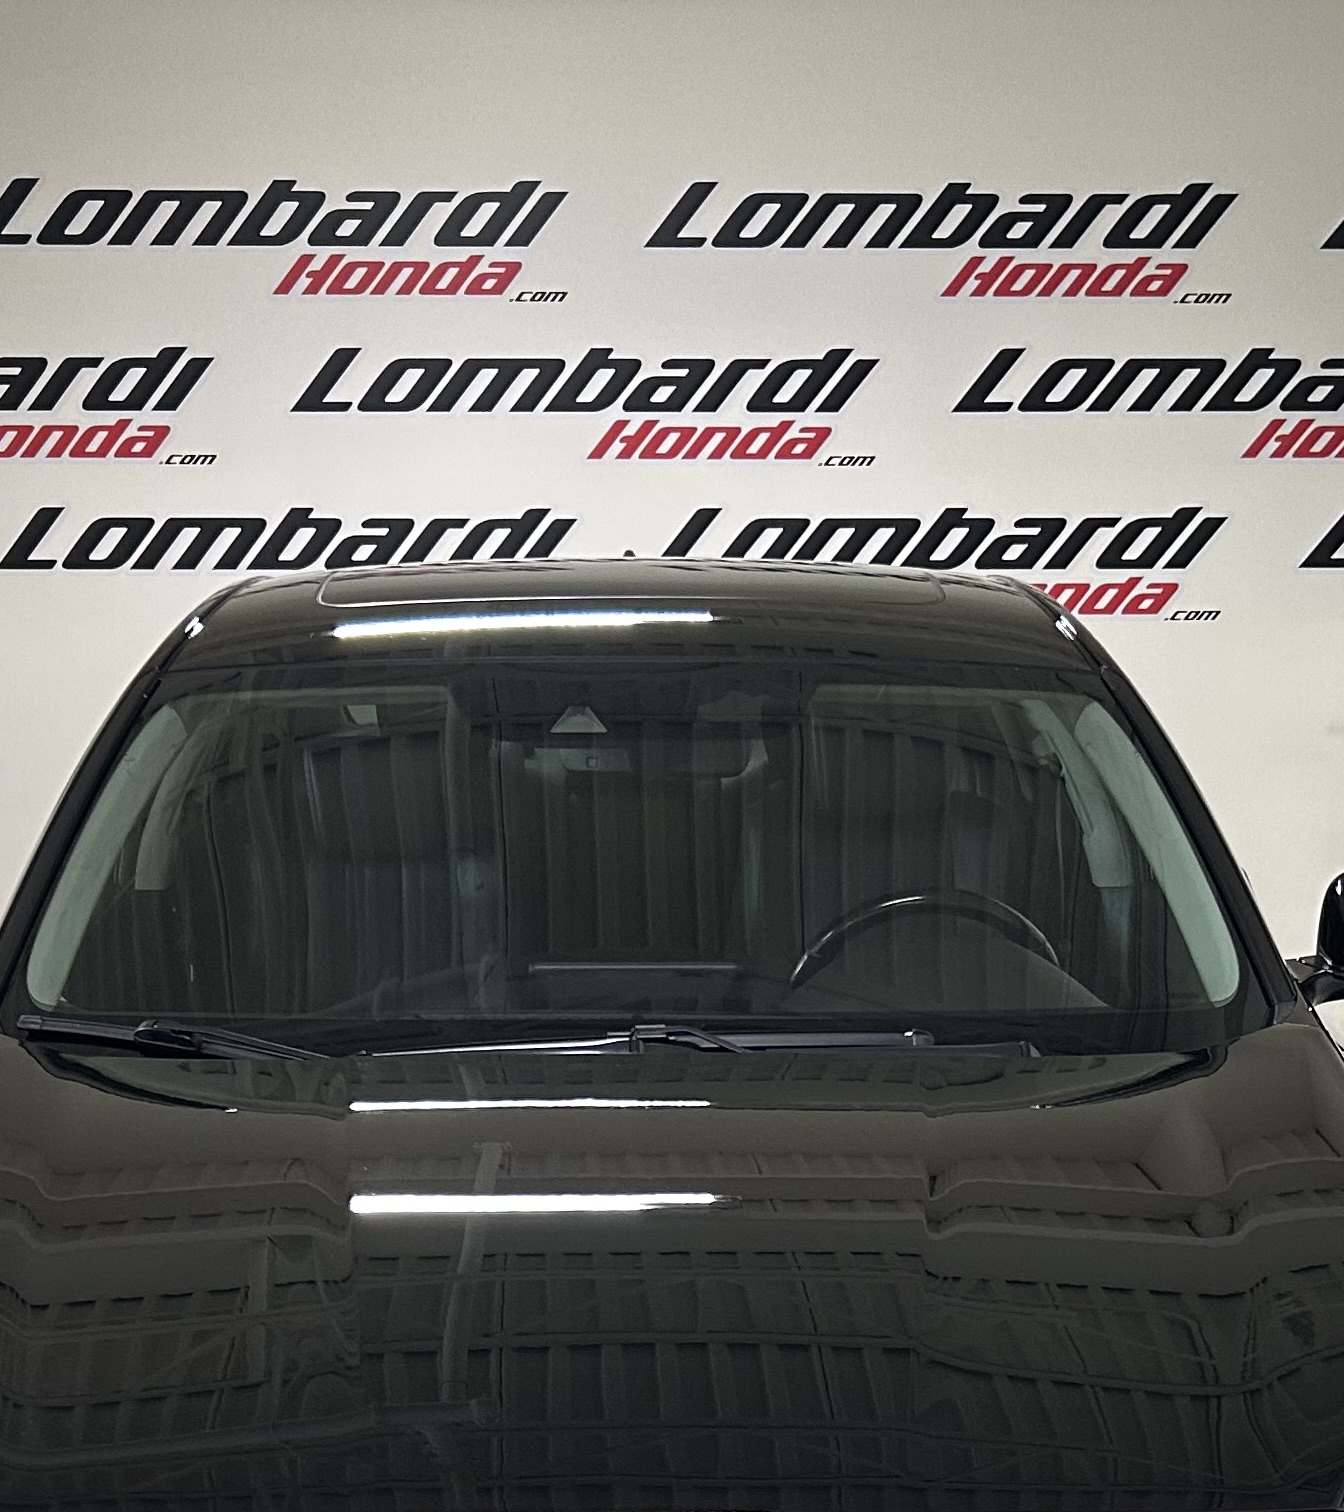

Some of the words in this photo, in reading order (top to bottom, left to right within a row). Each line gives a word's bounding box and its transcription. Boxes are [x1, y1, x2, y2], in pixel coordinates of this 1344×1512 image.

[643, 182, 1238, 248] Lombardi
[272, 254, 522, 296] Honda
[509, 291, 568, 302] .com
[940, 256, 1188, 297] Honda
[1173, 292, 1231, 304] .com
[290, 348, 879, 412] Lombardi
[158, 453, 217, 465] .com
[587, 419, 832, 460] Honda
[818, 455, 875, 467] .com
[661, 507, 1227, 570] Lombardi
[1165, 610, 1221, 621] .com
